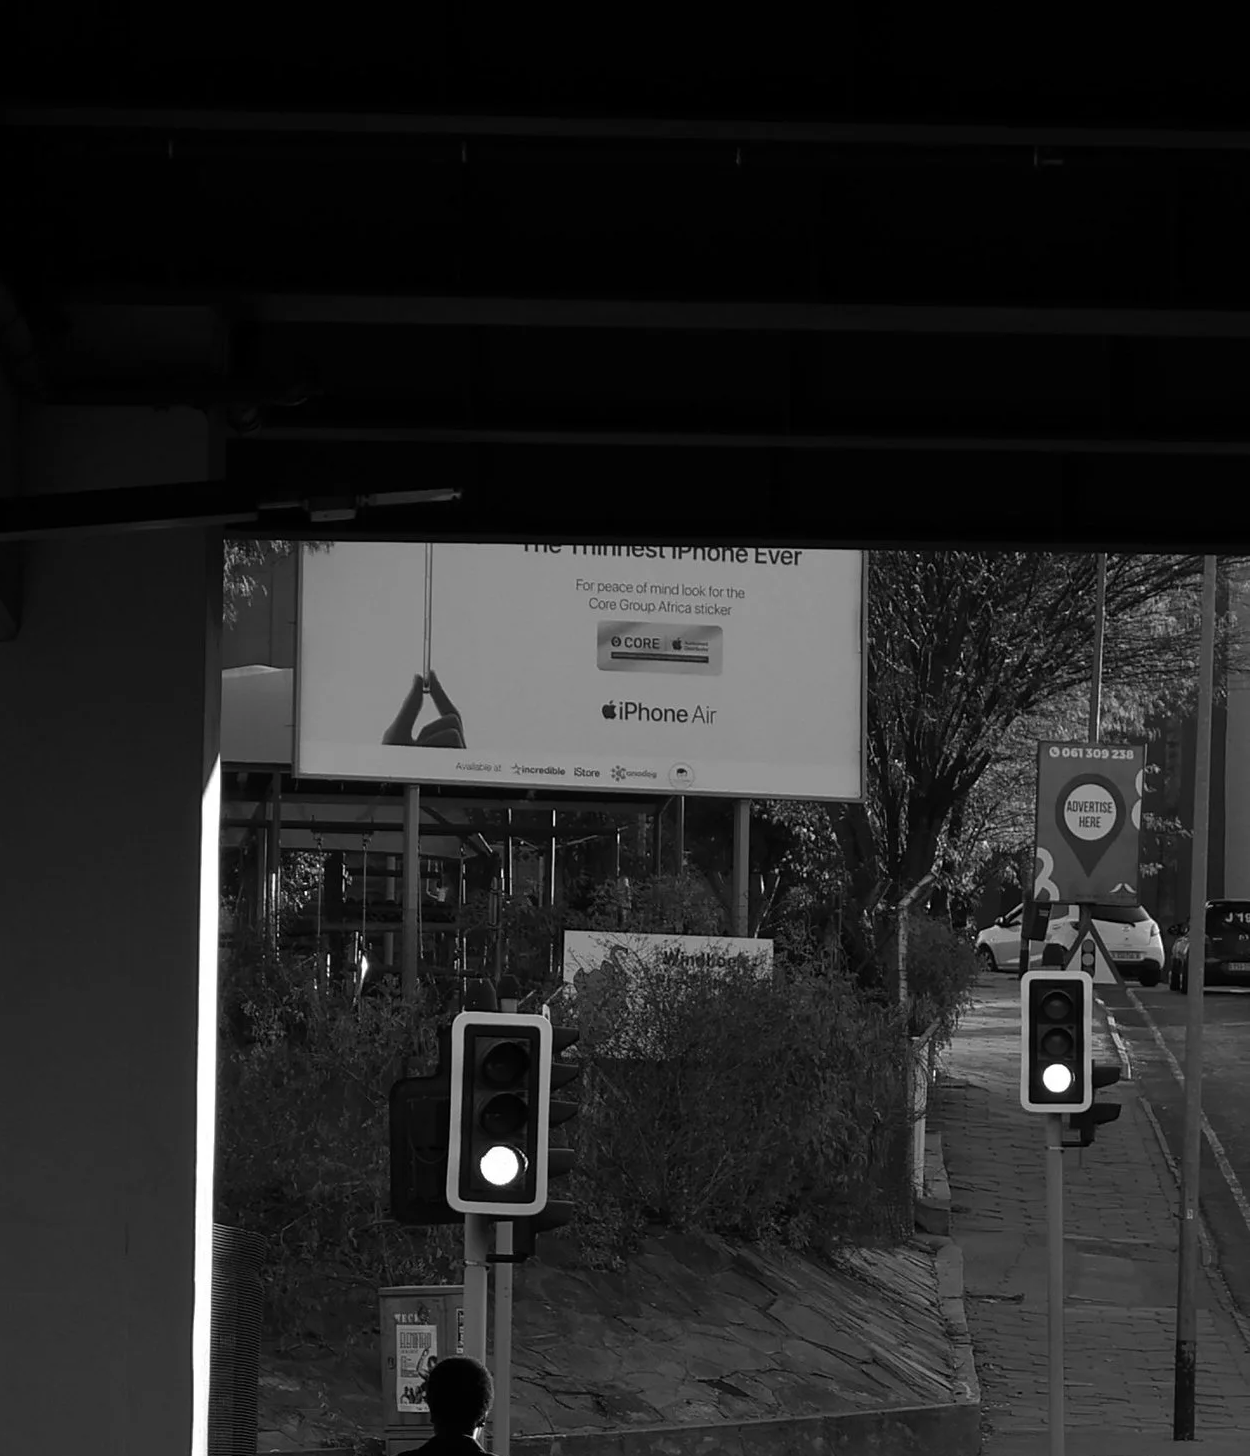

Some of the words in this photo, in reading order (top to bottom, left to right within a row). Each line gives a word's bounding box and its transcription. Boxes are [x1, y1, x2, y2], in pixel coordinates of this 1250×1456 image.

[754, 547, 803, 566] Ever
[575, 578, 595, 592] For
[597, 581, 634, 596] peace
[635, 582, 648, 594] of
[650, 583, 680, 596] mind
[681, 583, 706, 598] look
[708, 586, 725, 598] for
[726, 586, 746, 599] the
[588, 596, 617, 611] Core
[619, 598, 656, 614] Group
[658, 600, 692, 614] Africa
[694, 603, 733, 616] sticker
[624, 637, 661, 650] CORE
[619, 701, 688, 723] iPhone
[691, 705, 717, 724] Air
[1061, 747, 1083, 758] 061
[1085, 748, 1110, 759] 309
[1111, 749, 1135, 760] 238
[521, 764, 566, 777] incredible
[1066, 800, 1114, 814] ADVERTISE
[1078, 816, 1102, 828] HERE
